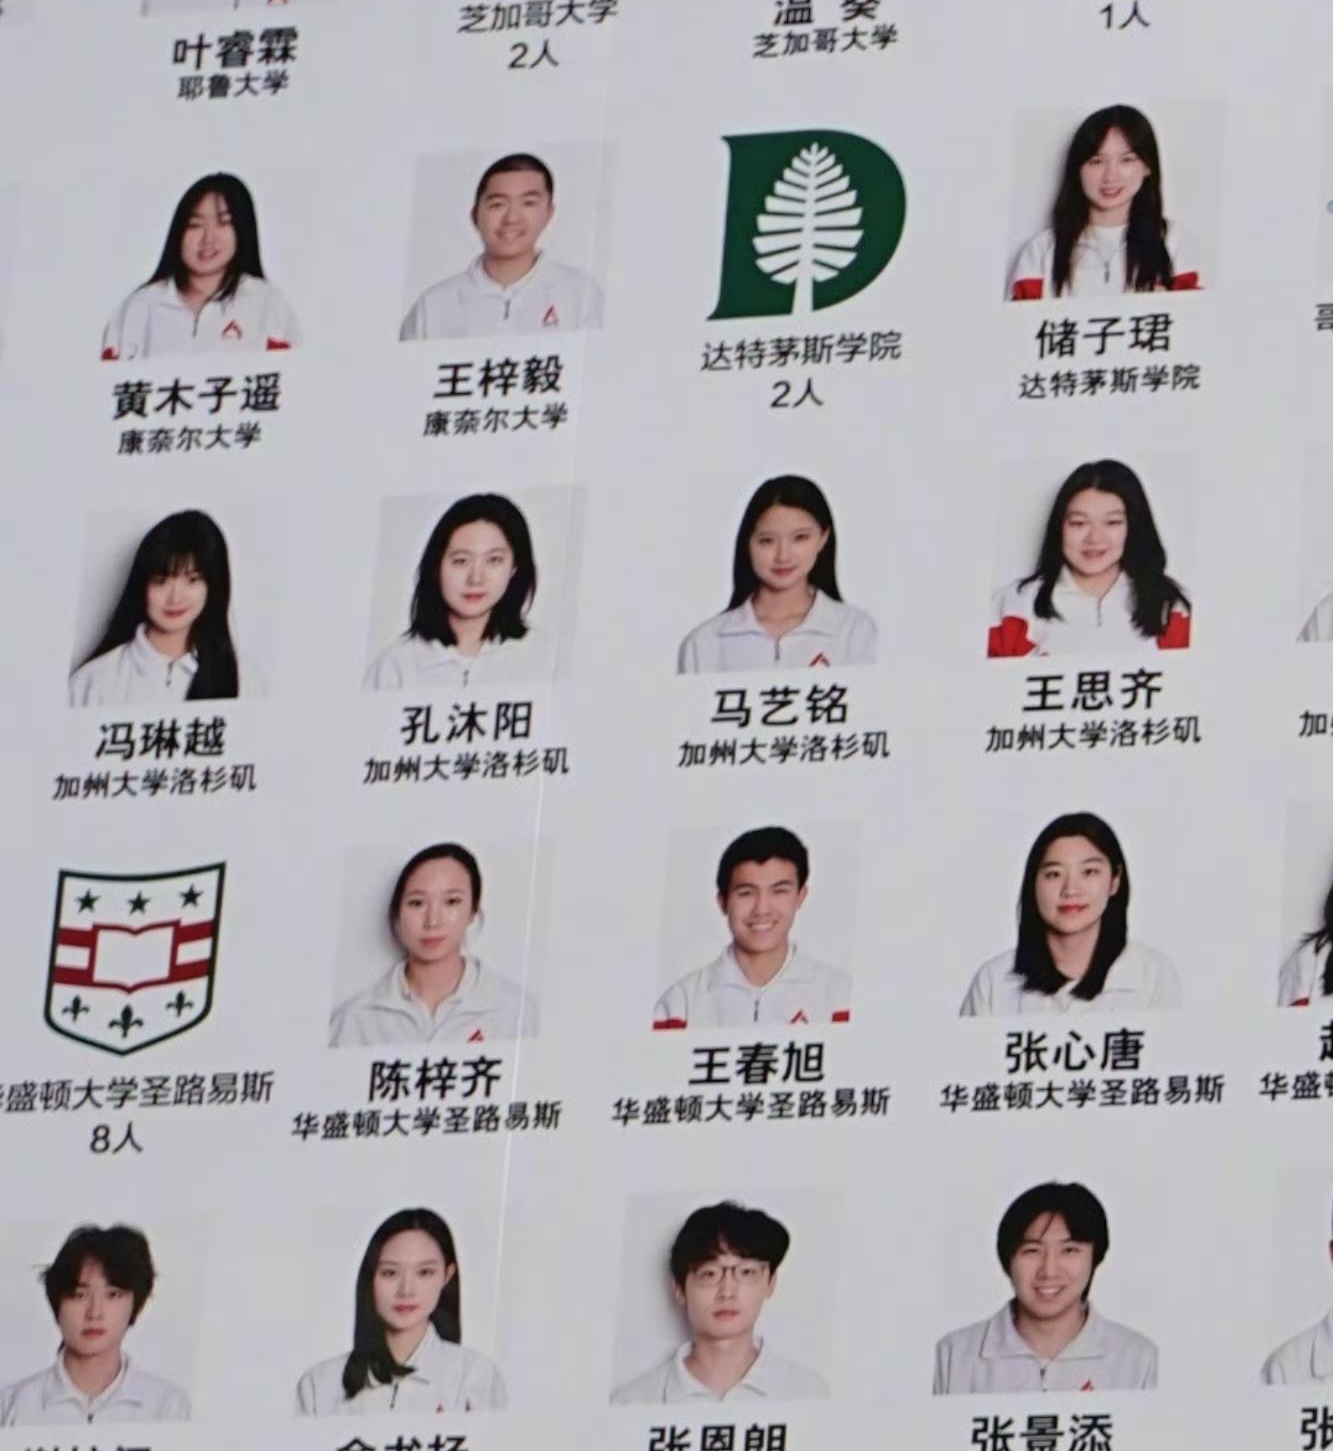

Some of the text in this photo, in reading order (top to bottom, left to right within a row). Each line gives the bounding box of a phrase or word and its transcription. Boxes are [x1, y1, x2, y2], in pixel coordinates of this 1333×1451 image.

[1100, 0, 1150, 30] 1人
[508, 39, 559, 70] 2人
[753, 23, 898, 59] 芝加哥大学
[177, 69, 289, 101] 耶鲁大学
[700, 329, 902, 371] 达特茅斯学院
[1034, 312, 1174, 360] 储子珺
[112, 371, 281, 421] 黄木子遥
[433, 354, 564, 399] 王梓毅
[770, 377, 824, 409] 2人
[1018, 363, 1201, 399] 达特茅斯学院
[117, 421, 262, 456] 康奈尔大学
[423, 402, 568, 437] 康奈尔大学
[710, 683, 849, 729] 马艺铭
[1021, 667, 1163, 713] 王思齐
[94, 715, 227, 762] 冯琳越
[400, 701, 533, 746] 孔沐阳
[985, 715, 1202, 753] 加州大学洛杉矶
[363, 746, 570, 784] 加州大学洛杉矶
[677, 730, 891, 768] 加州大学洛杉矶
[52, 763, 257, 801] 加州大学洛杉矶
[687, 1040, 825, 1087] 王春旭
[1005, 1026, 1146, 1075] 张心唐
[0, 1070, 274, 1113] 盛顿大学圣路易斯
[367, 1054, 503, 1103] 陈梓齐
[939, 1074, 1225, 1113] 华盛顿大学圣路易斯
[291, 1100, 562, 1141] 华盛顿大学圣路易斯
[611, 1086, 891, 1127] 华盛顿大学圣路易斯
[89, 1121, 143, 1154] 8人
